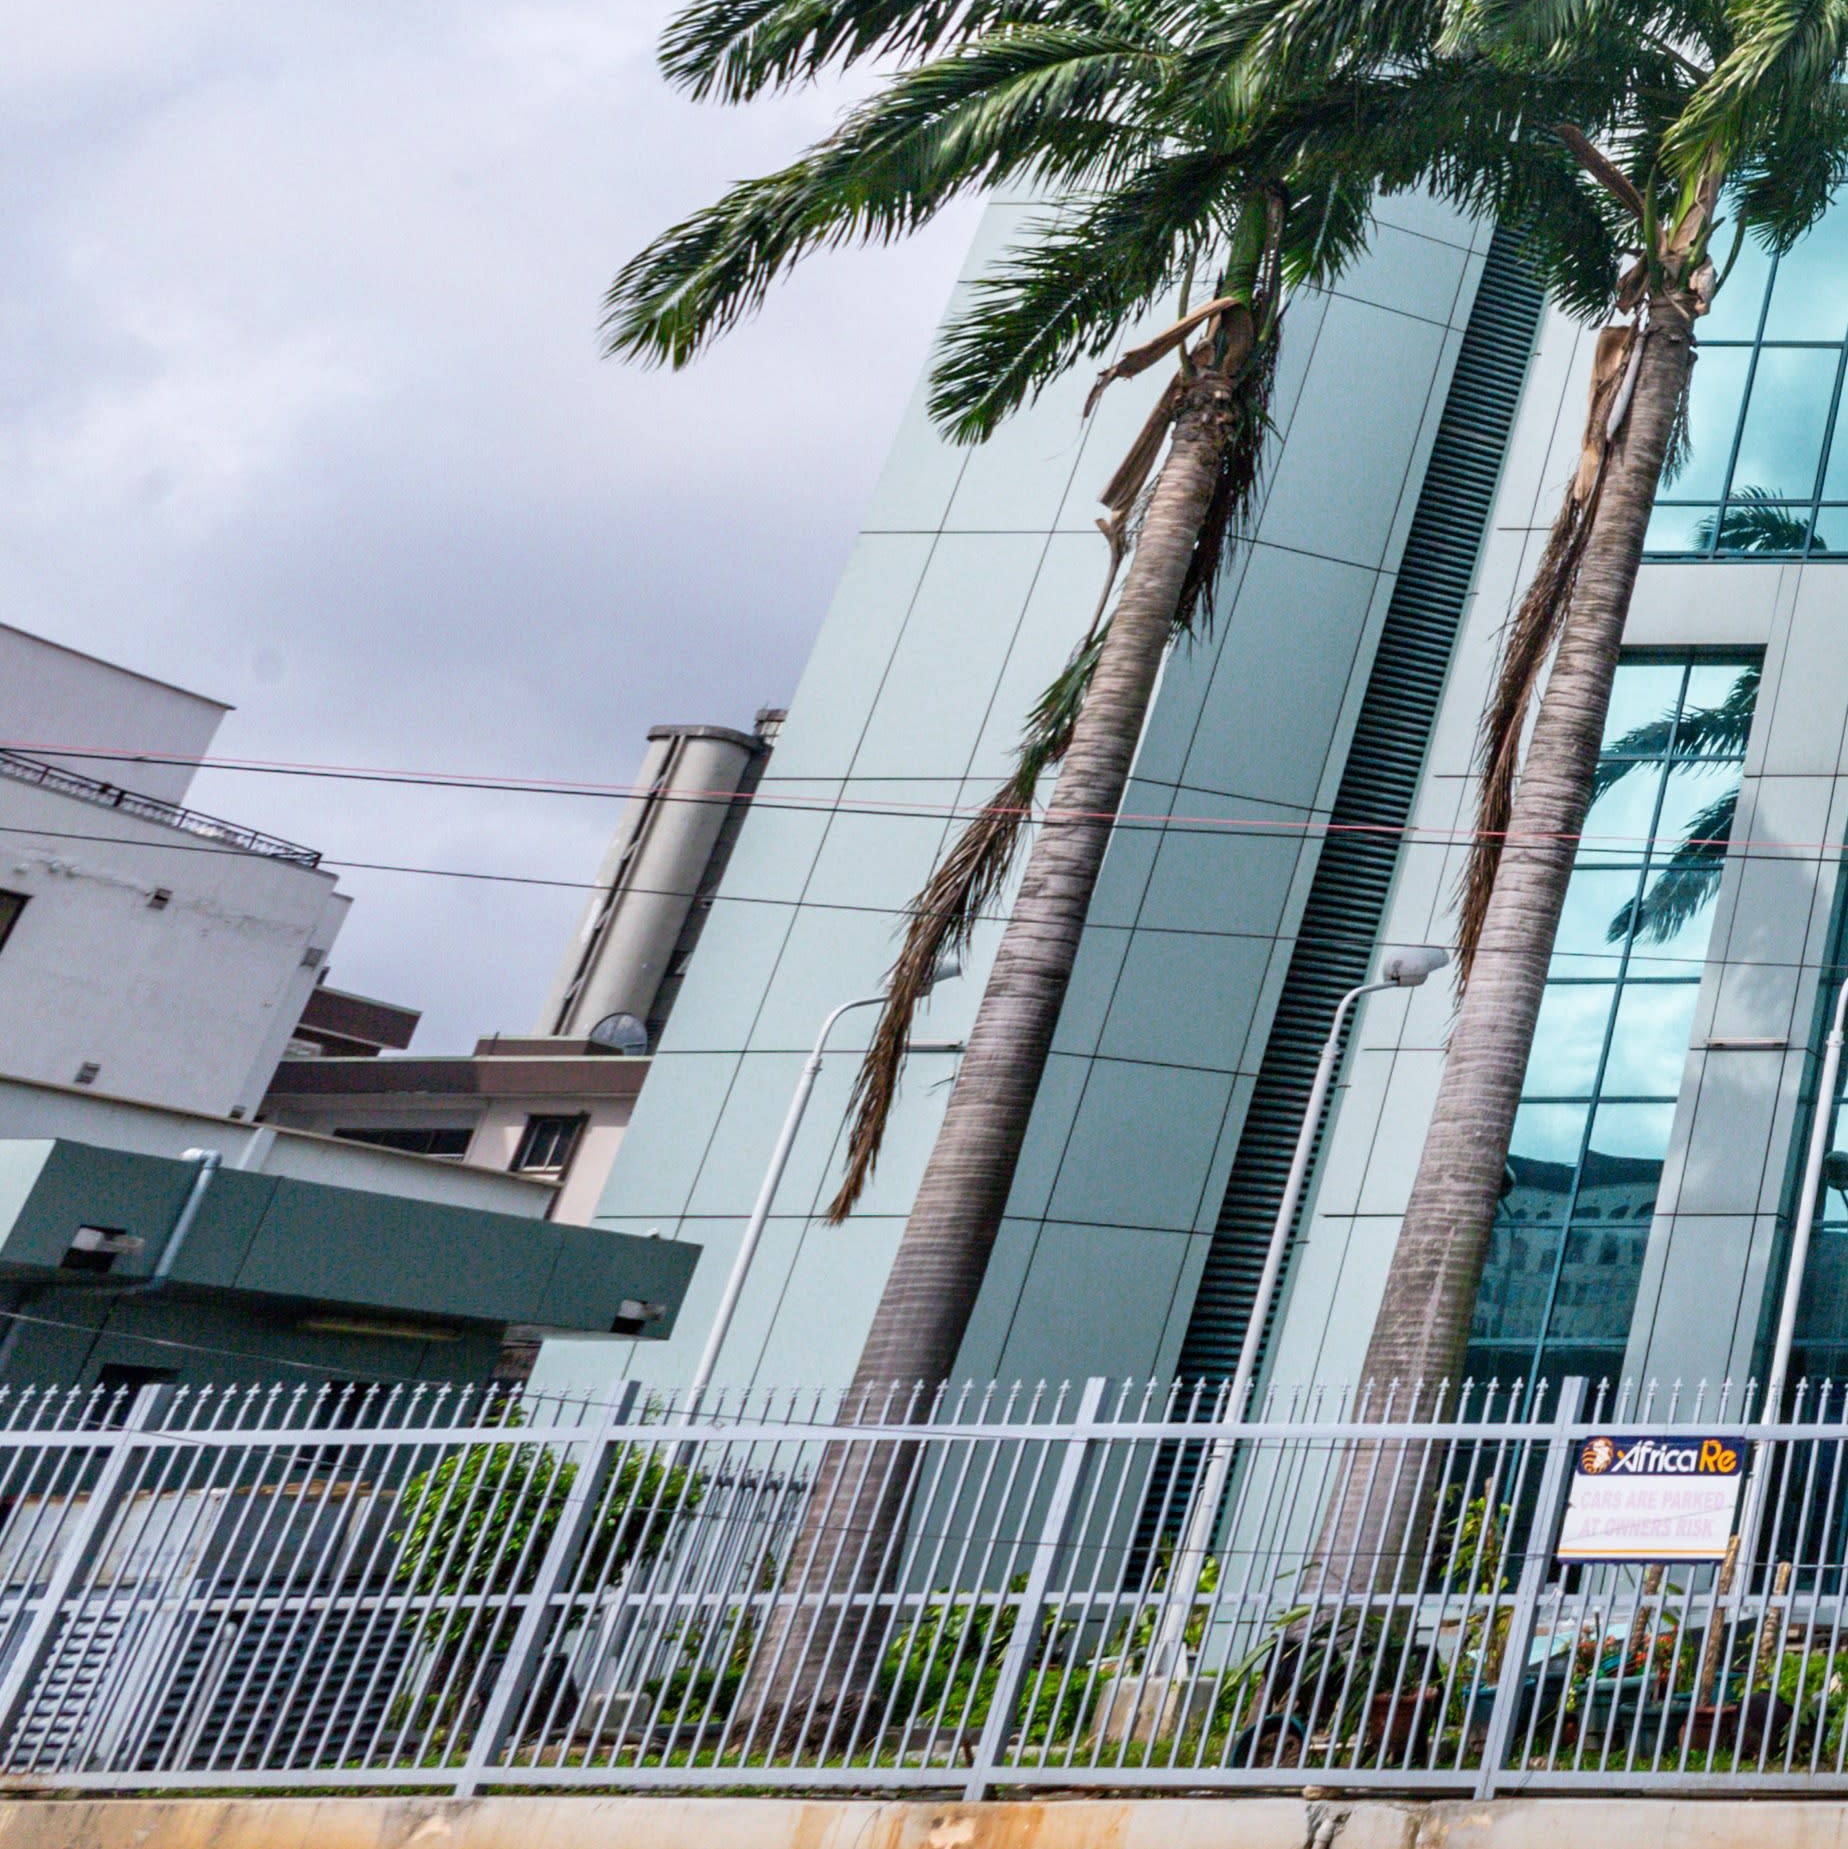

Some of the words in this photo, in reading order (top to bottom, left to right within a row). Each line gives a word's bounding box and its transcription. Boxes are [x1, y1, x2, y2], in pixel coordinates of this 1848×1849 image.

[1611, 1440, 1698, 1472] Africa
[1699, 1439, 1737, 1473] Re
[1580, 1490, 1622, 1510] CARS
[1625, 1490, 1658, 1510] ARE
[1661, 1490, 1725, 1511] PARKED
[1579, 1517, 1602, 1537] AT
[1604, 1518, 1673, 1537] OWNERS
[1675, 1518, 1714, 1537] RISK
